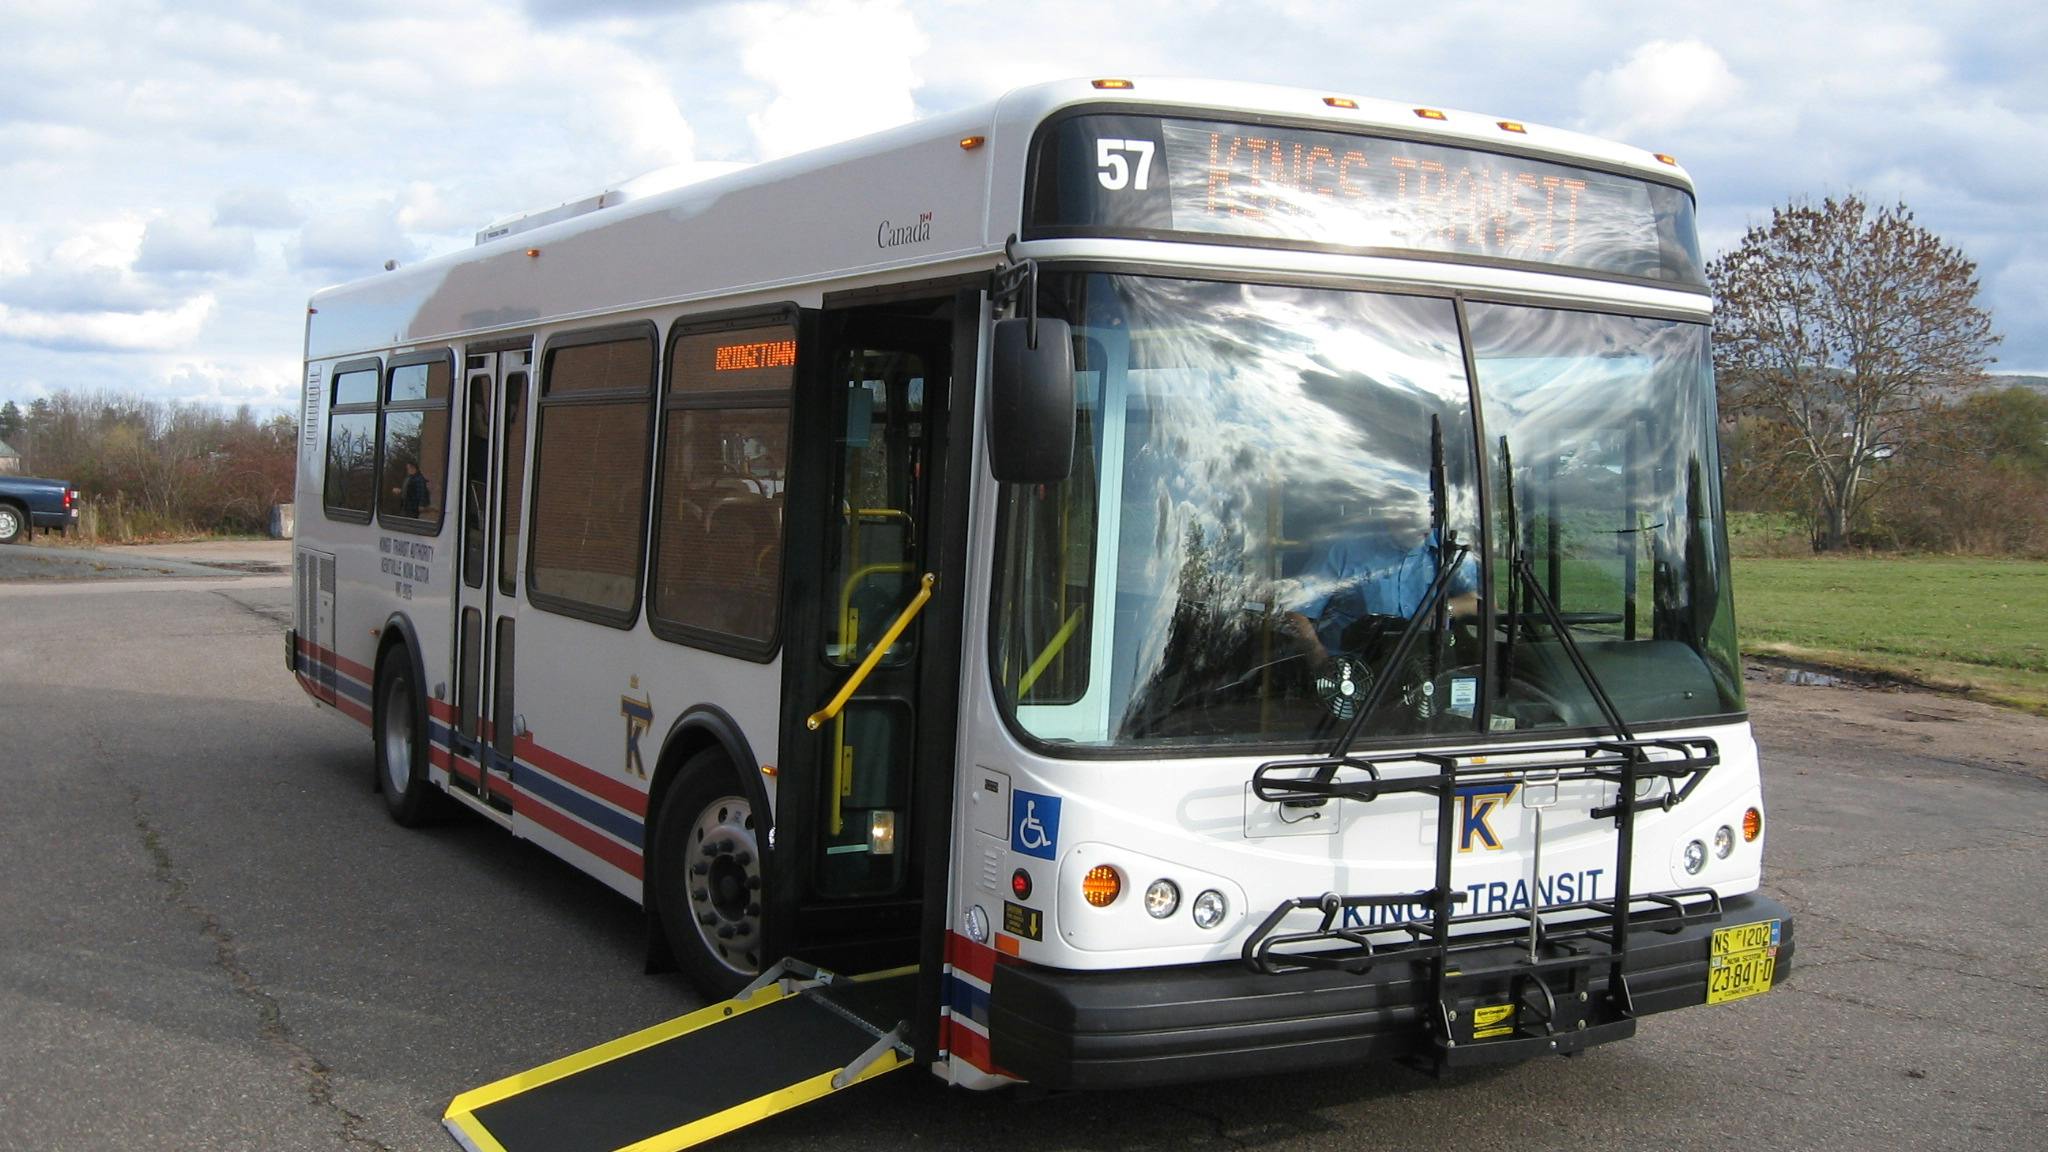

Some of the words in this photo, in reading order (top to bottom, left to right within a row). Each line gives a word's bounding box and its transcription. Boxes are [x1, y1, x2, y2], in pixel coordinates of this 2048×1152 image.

[1096, 138, 1155, 191] 57
[1391, 155, 1587, 254] TRANSIT
[877, 214, 931, 249] Canada
[715, 340, 796, 371] BRIDGETOWN
[1466, 868, 1605, 916] TRANSIT
[1714, 932, 1730, 953] NS
